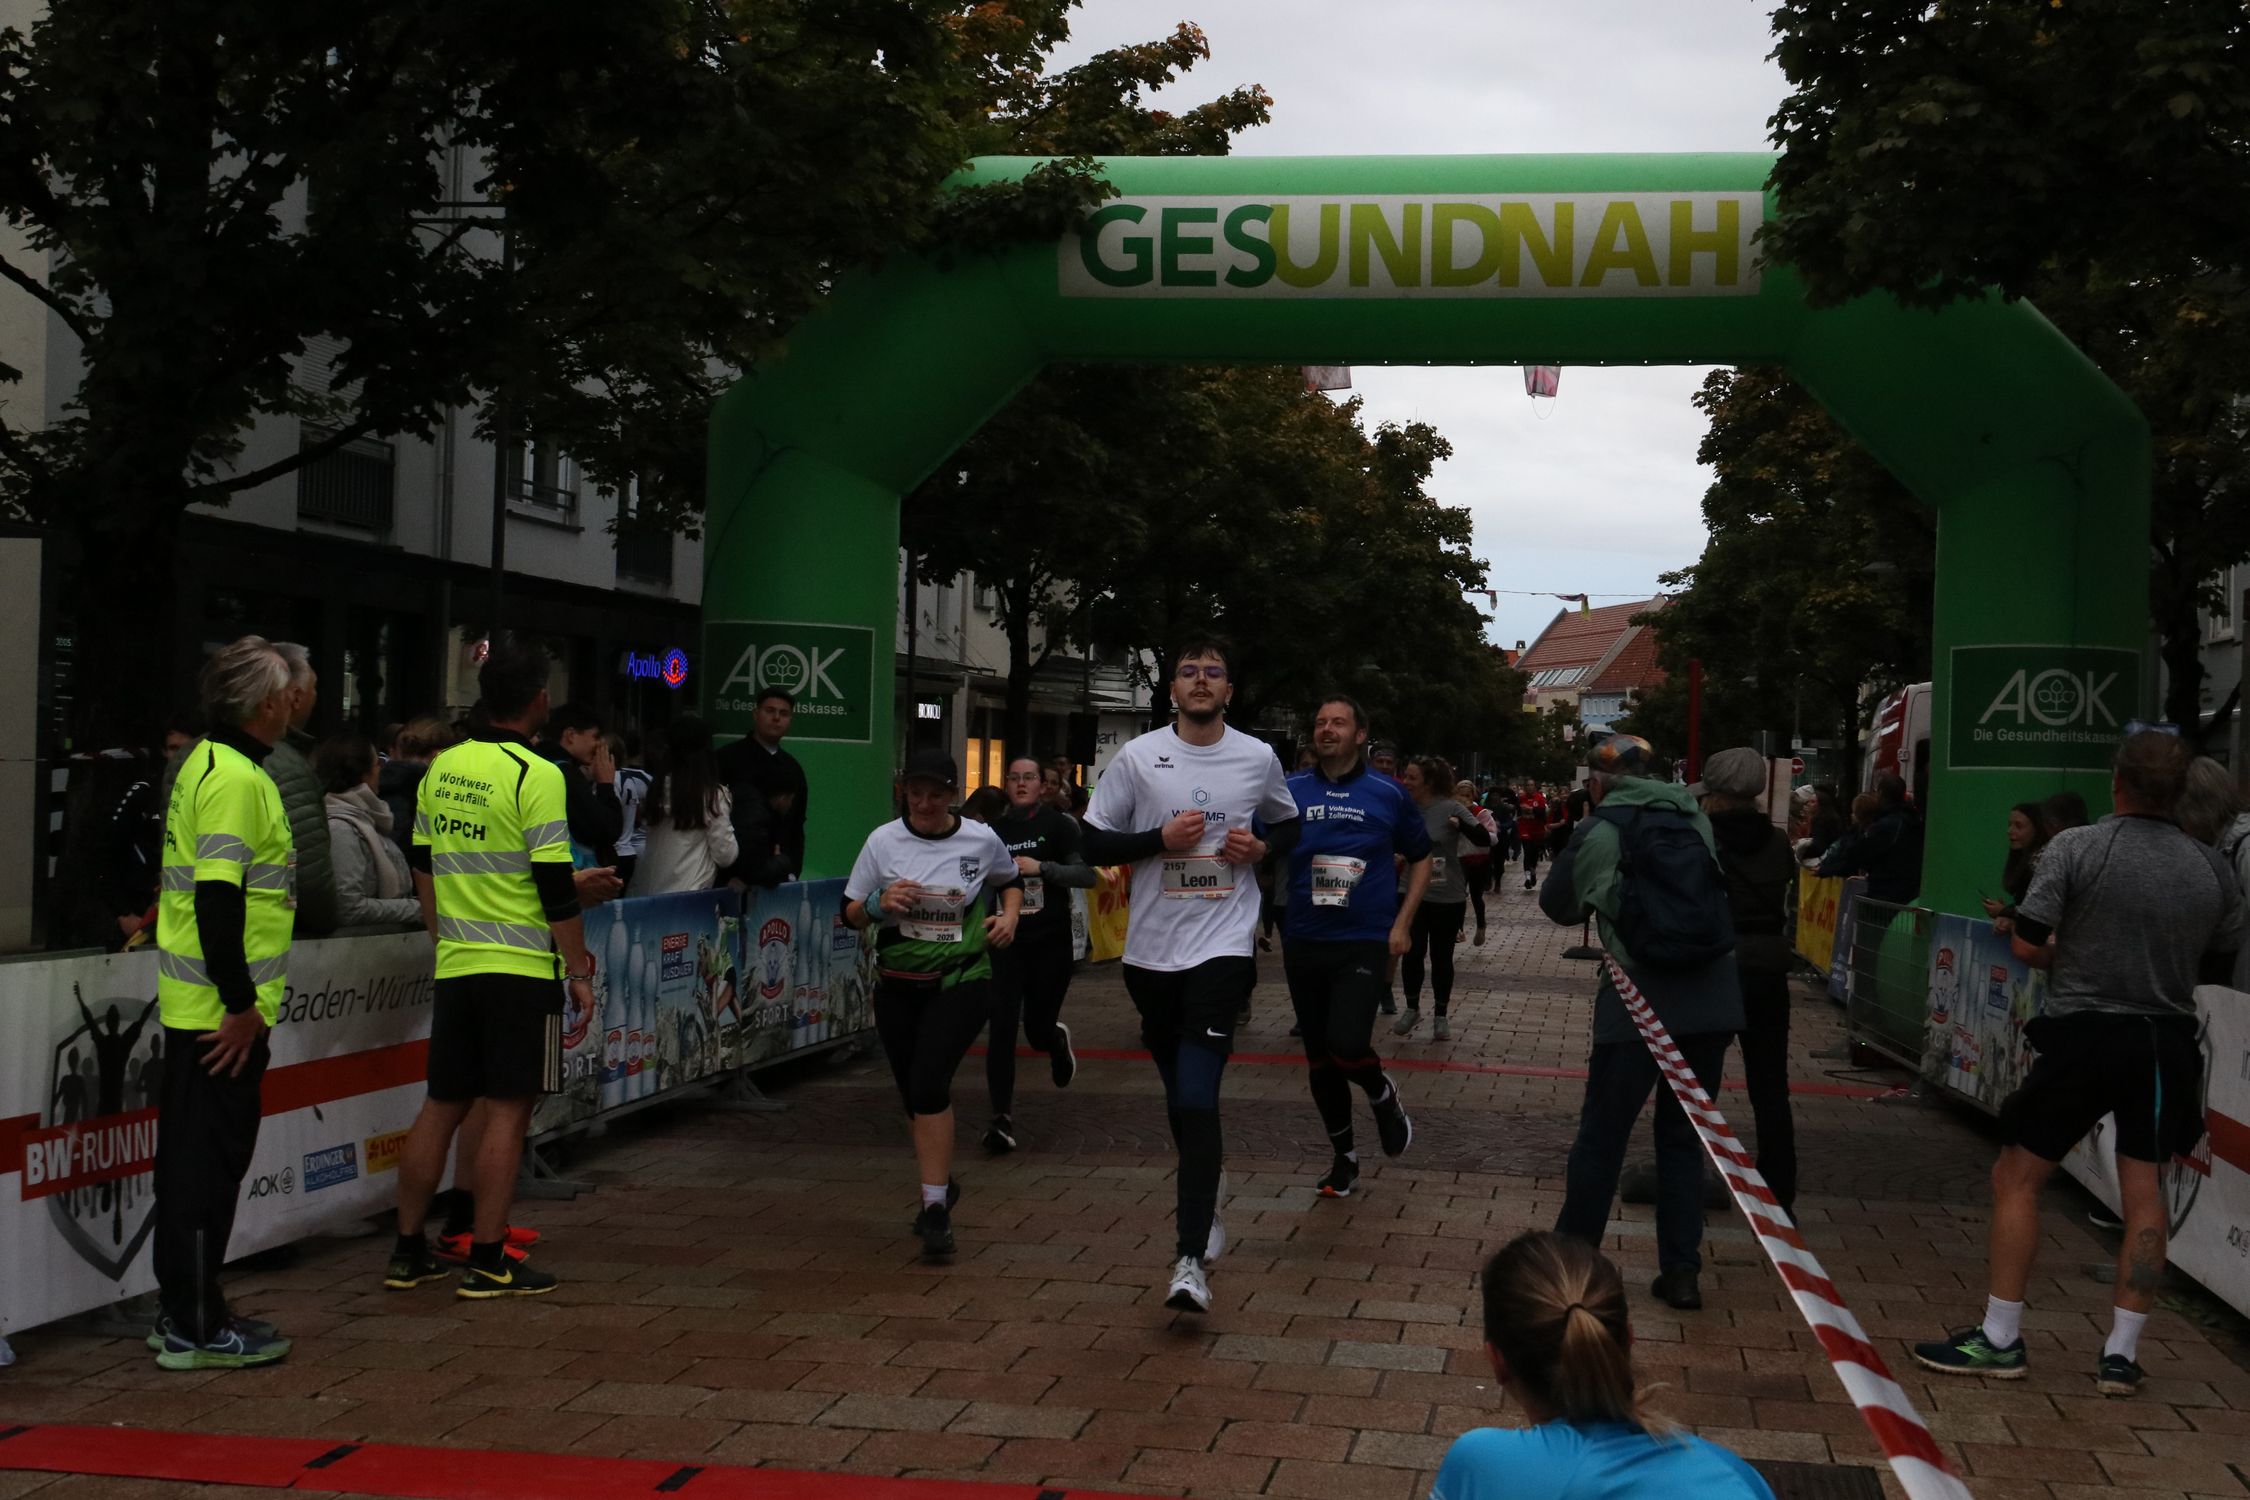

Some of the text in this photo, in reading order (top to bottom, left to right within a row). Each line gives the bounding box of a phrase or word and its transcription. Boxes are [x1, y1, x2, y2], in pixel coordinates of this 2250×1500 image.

[1080, 201, 1738, 288] GESUNDNAH
[627, 651, 662, 682] Apollo
[720, 643, 847, 700] AOK
[715, 699, 730, 711] Die
[1977, 668, 2119, 728] AOK
[1974, 728, 1993, 742] Die
[440, 772, 494, 795] Workwear,
[435, 787, 490, 808] die auffällt.
[1326, 791, 1350, 799] Kempa
[1328, 805, 1366, 816] Volksbank
[450, 819, 486, 841] PCH
[1164, 862, 1186, 871] 2157
[1181, 873, 1218, 888] Leon
[1315, 876, 1355, 889] Markus
[761, 919, 788, 942] APOLLO
[755, 1003, 789, 1029] SPORT
[305, 1150, 347, 1173] ERDINGER
[248, 1175, 279, 1200] AOK
